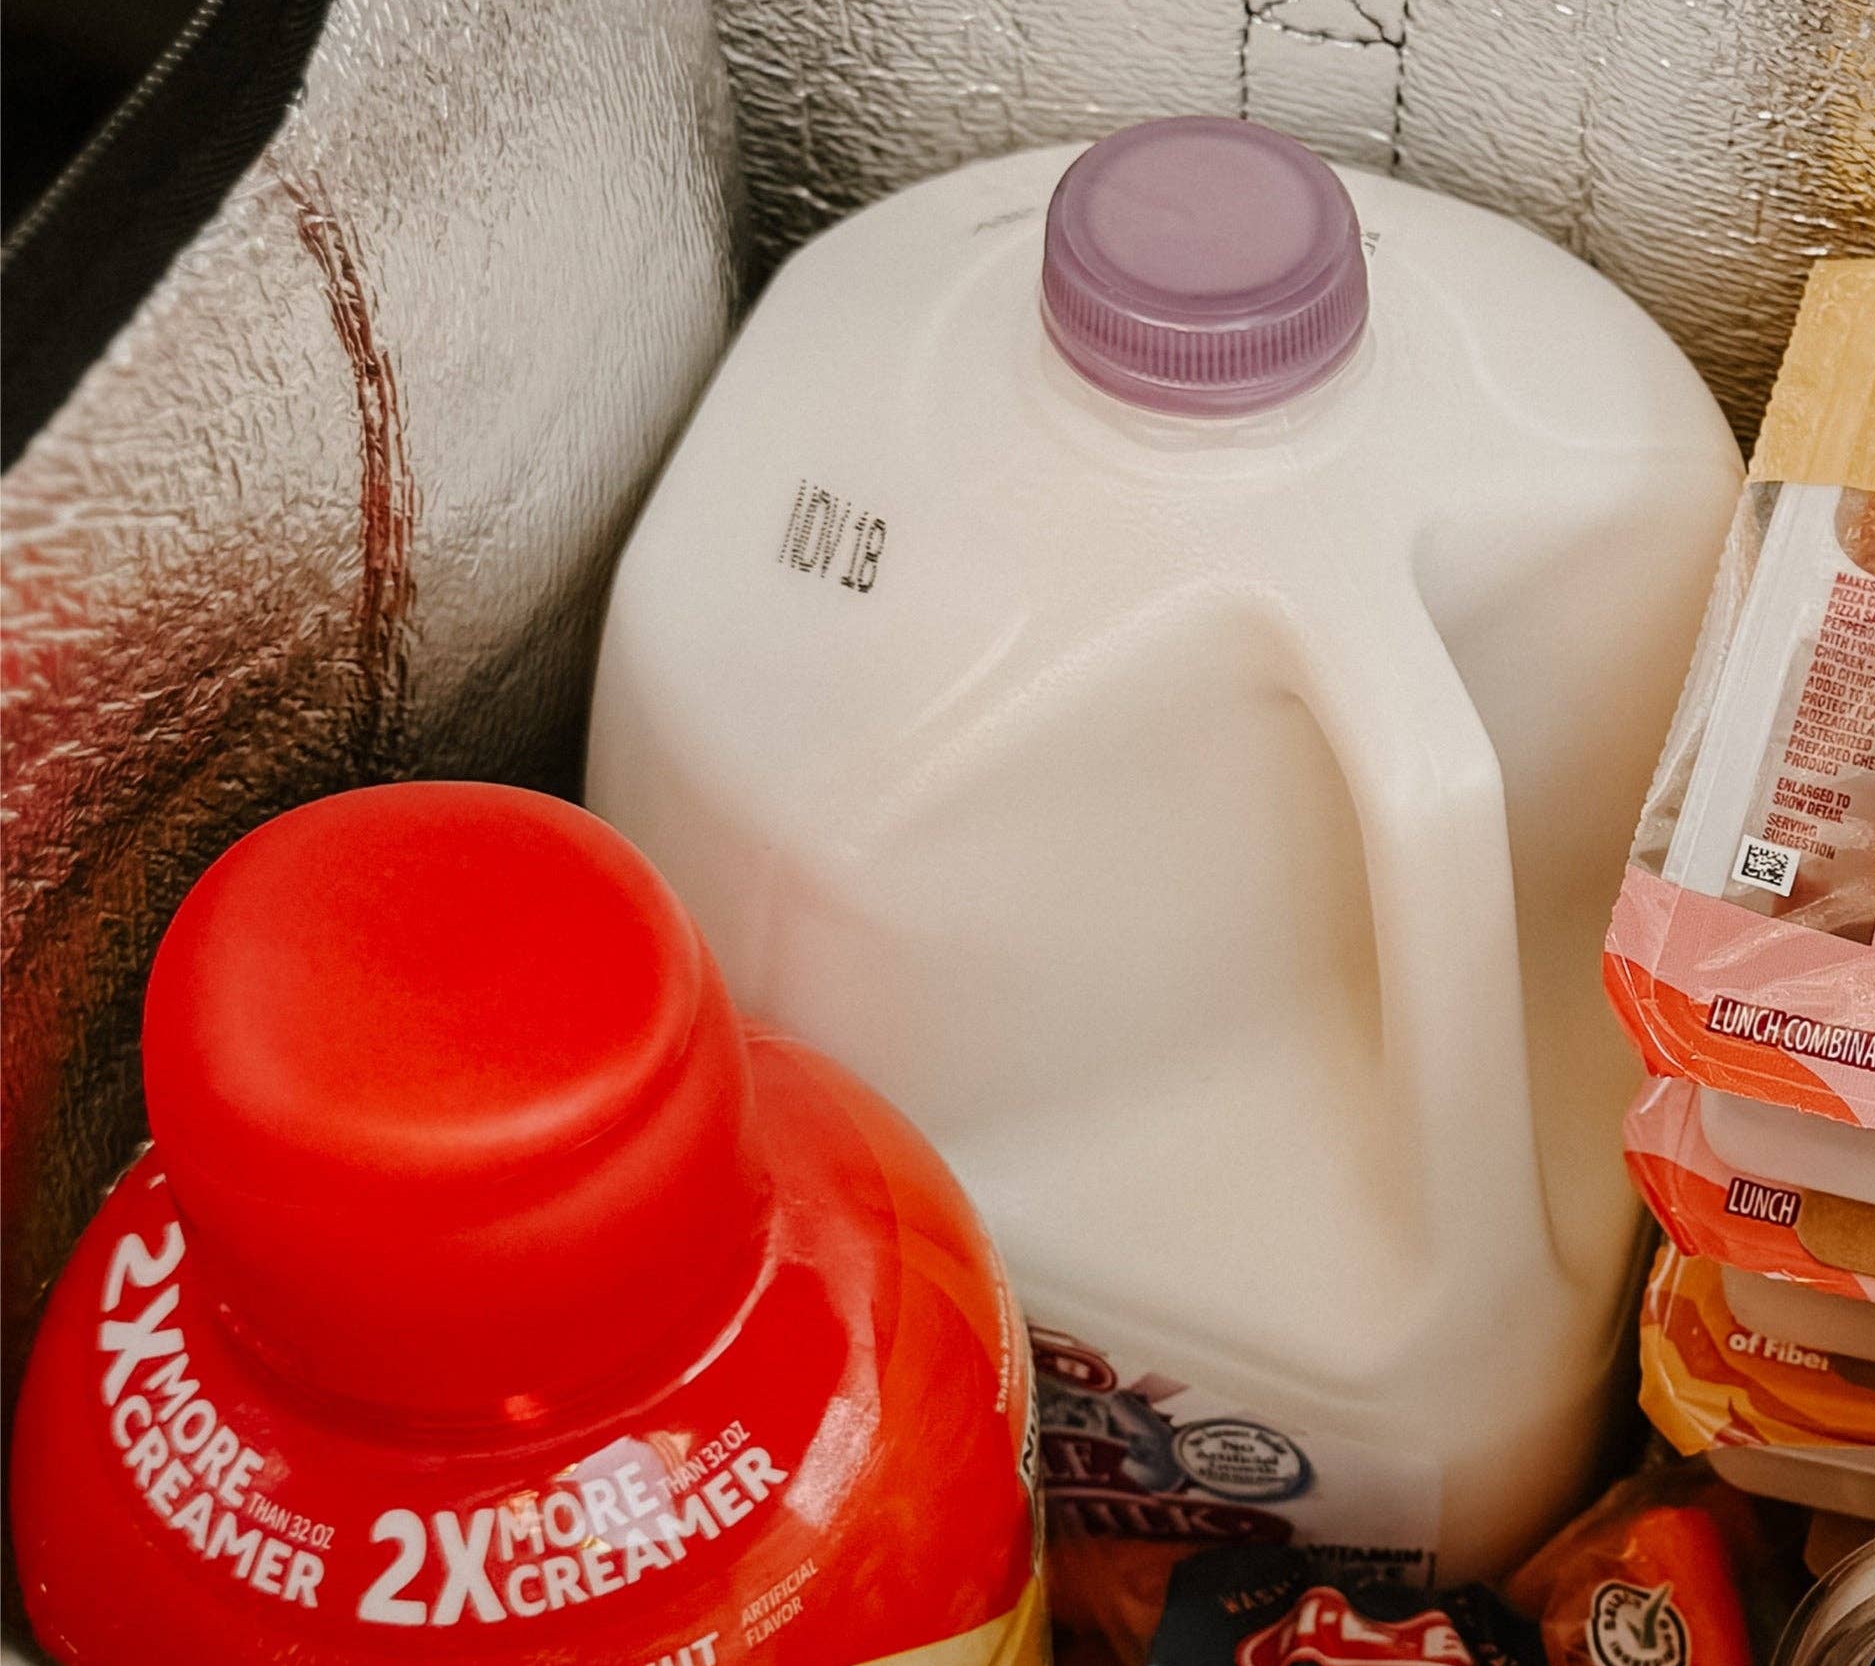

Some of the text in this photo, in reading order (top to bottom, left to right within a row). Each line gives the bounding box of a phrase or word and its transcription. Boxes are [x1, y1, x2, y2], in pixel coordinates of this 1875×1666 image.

[1828, 600, 1860, 620] PIZZA
[1832, 587, 1864, 607] PIZZA
[1820, 630, 1848, 648] WITH
[1810, 661, 1836, 678] AND
[1814, 644, 1864, 670] CHICKEN
[1801, 690, 1853, 714] PROTECT
[1806, 675, 1846, 697] ADDED
[1848, 688, 1863, 703] TO
[1793, 720, 1873, 752] PASTEURIZED
[1797, 706, 1875, 738] MOZZARELLA
[1784, 751, 1841, 776] PRODUCT
[1788, 734, 1850, 764] PREPARED
[1773, 792, 1807, 812] SHOW
[1777, 777, 1852, 809] ENLARGED TO
[1767, 813, 1818, 837] SERVING
[1762, 827, 1837, 860] SUGGESTION
[1711, 998, 1783, 1044] LUNCH
[1728, 1180, 1797, 1224] LUNCH
[98, 1221, 185, 1405] 2X
[1729, 1333, 1761, 1354] of
[144, 1353, 335, 1549] MORE THAN 32 OZ
[111, 1394, 325, 1608] CREAMER
[498, 1420, 751, 1561] MORE THAN 32 OZ
[506, 1446, 788, 1618] CREAMER
[358, 1507, 507, 1626] 2X
[740, 1557, 819, 1627] ARTIFICIAL
[744, 1597, 804, 1648] FLAVOR
